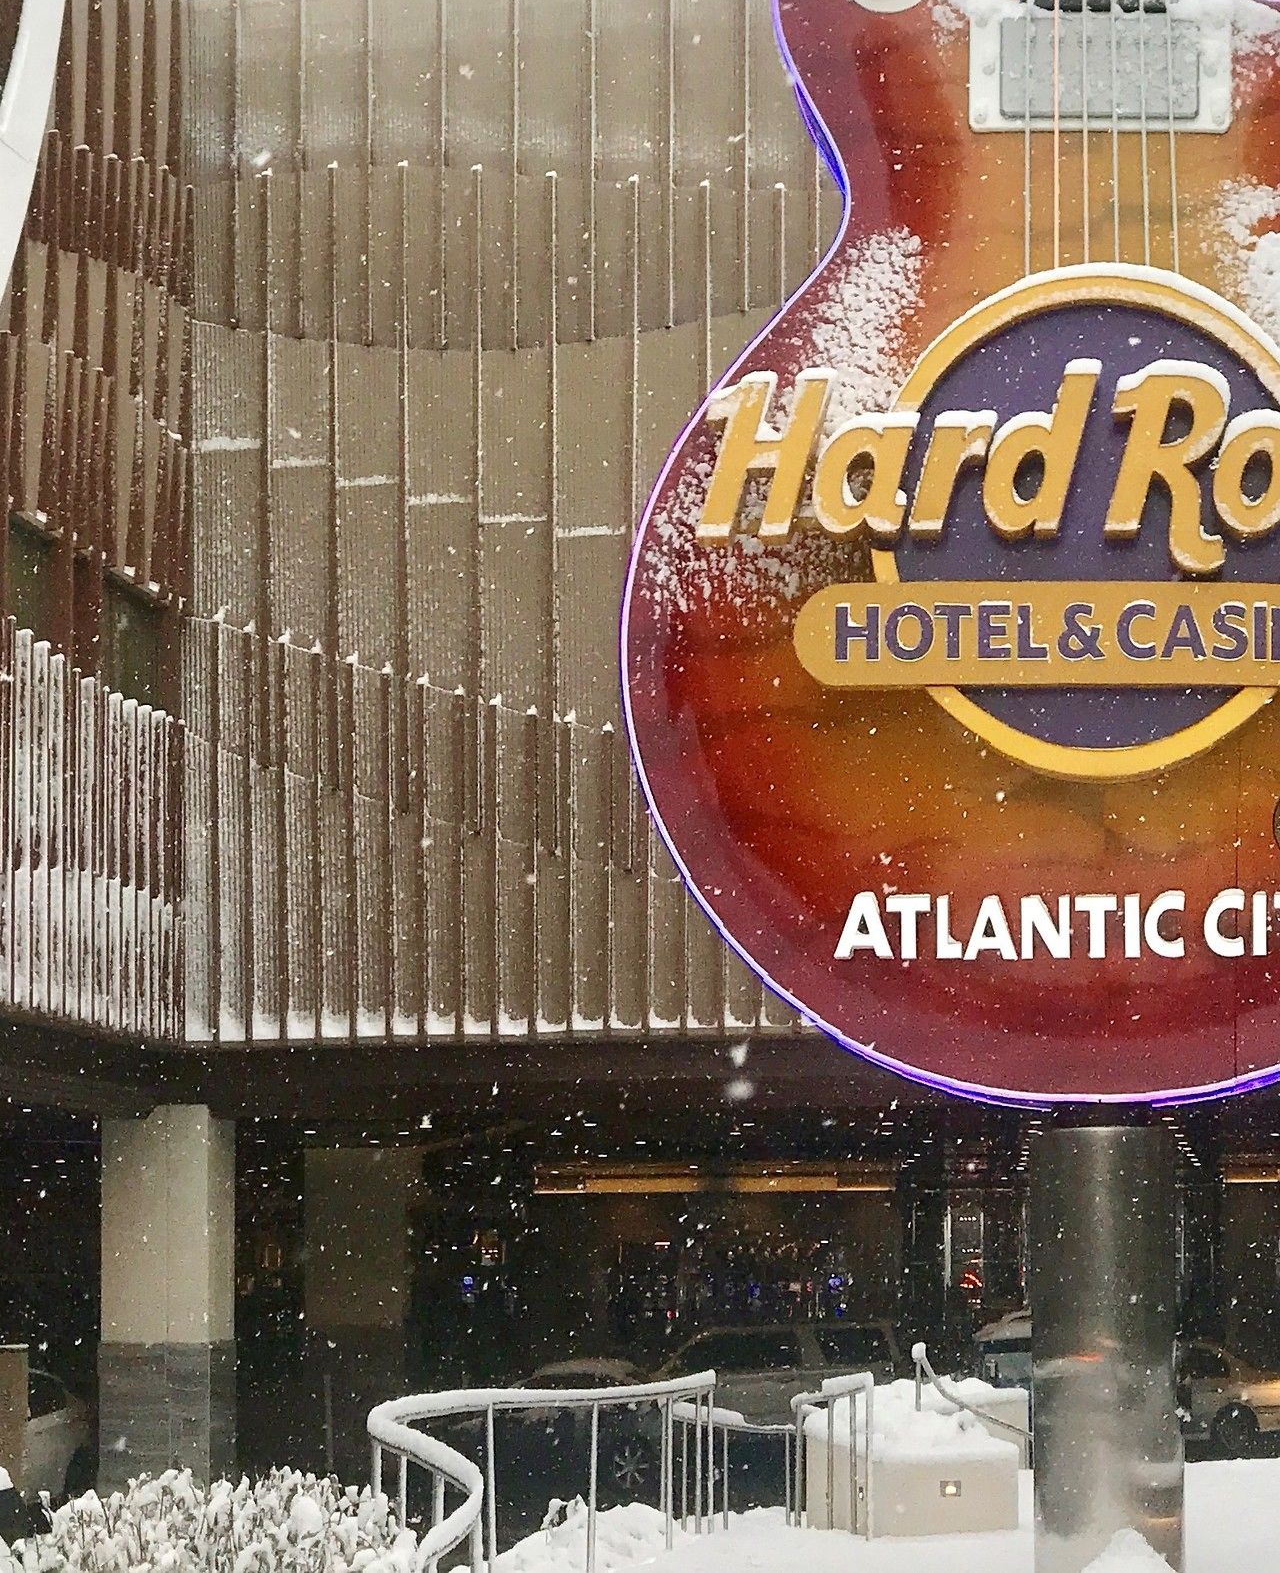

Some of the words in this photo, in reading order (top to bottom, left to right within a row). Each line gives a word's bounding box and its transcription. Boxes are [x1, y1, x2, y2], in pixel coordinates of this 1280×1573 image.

[697, 358, 1103, 543] Hard
[834, 601, 1048, 662] HOTEL
[833, 891, 1186, 960] ATLANTIC
